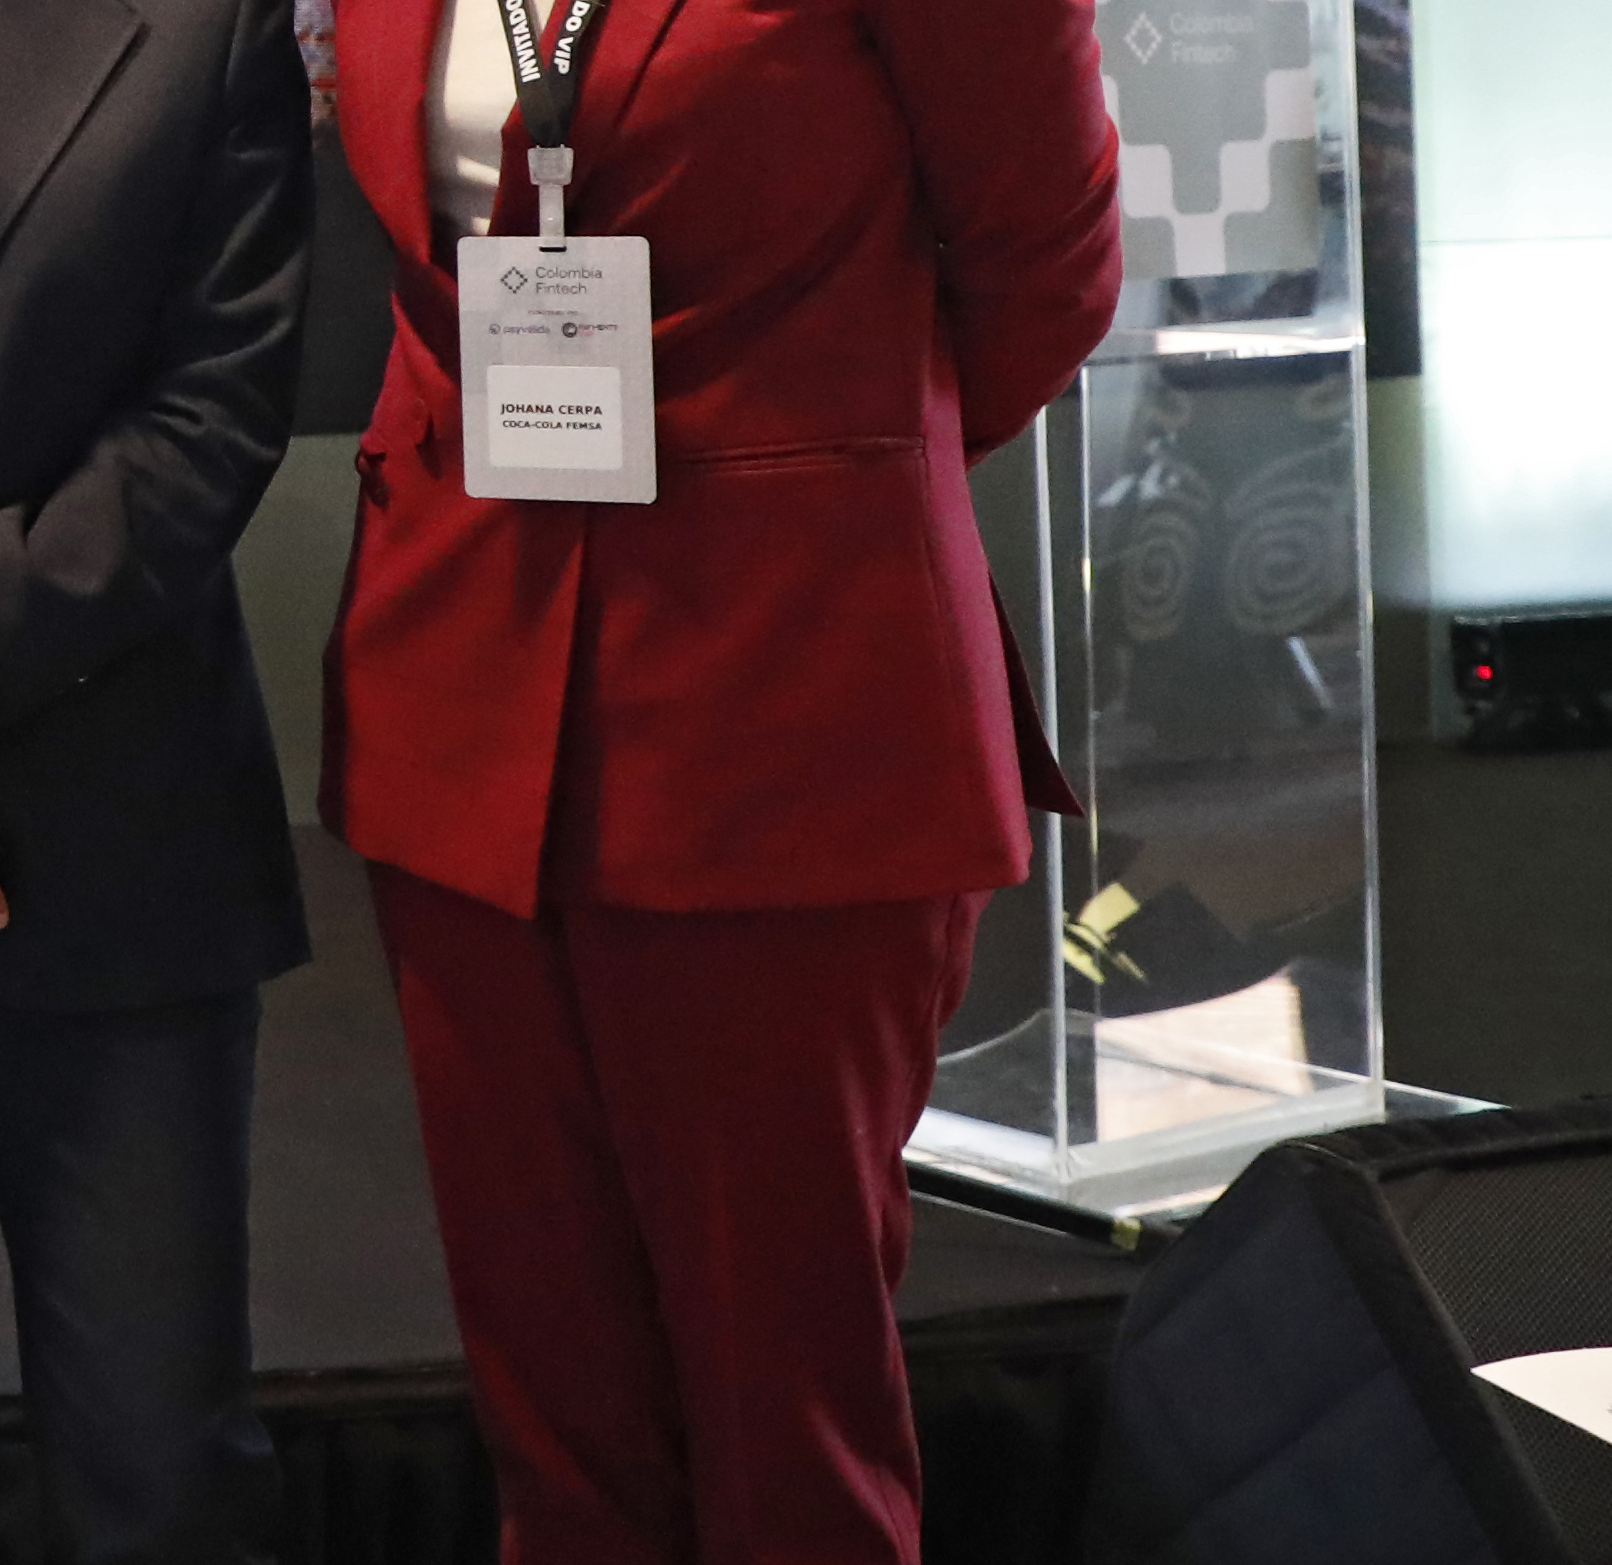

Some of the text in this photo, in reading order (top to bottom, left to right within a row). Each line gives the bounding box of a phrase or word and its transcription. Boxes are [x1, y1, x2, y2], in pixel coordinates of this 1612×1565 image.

[554, 34, 575, 75] VIP
[535, 266, 603, 280] Colombia
[535, 282, 588, 295] Fintech
[500, 403, 603, 416] JOHANA CERPA
[502, 420, 603, 431] COCA-COLA FEMSA
